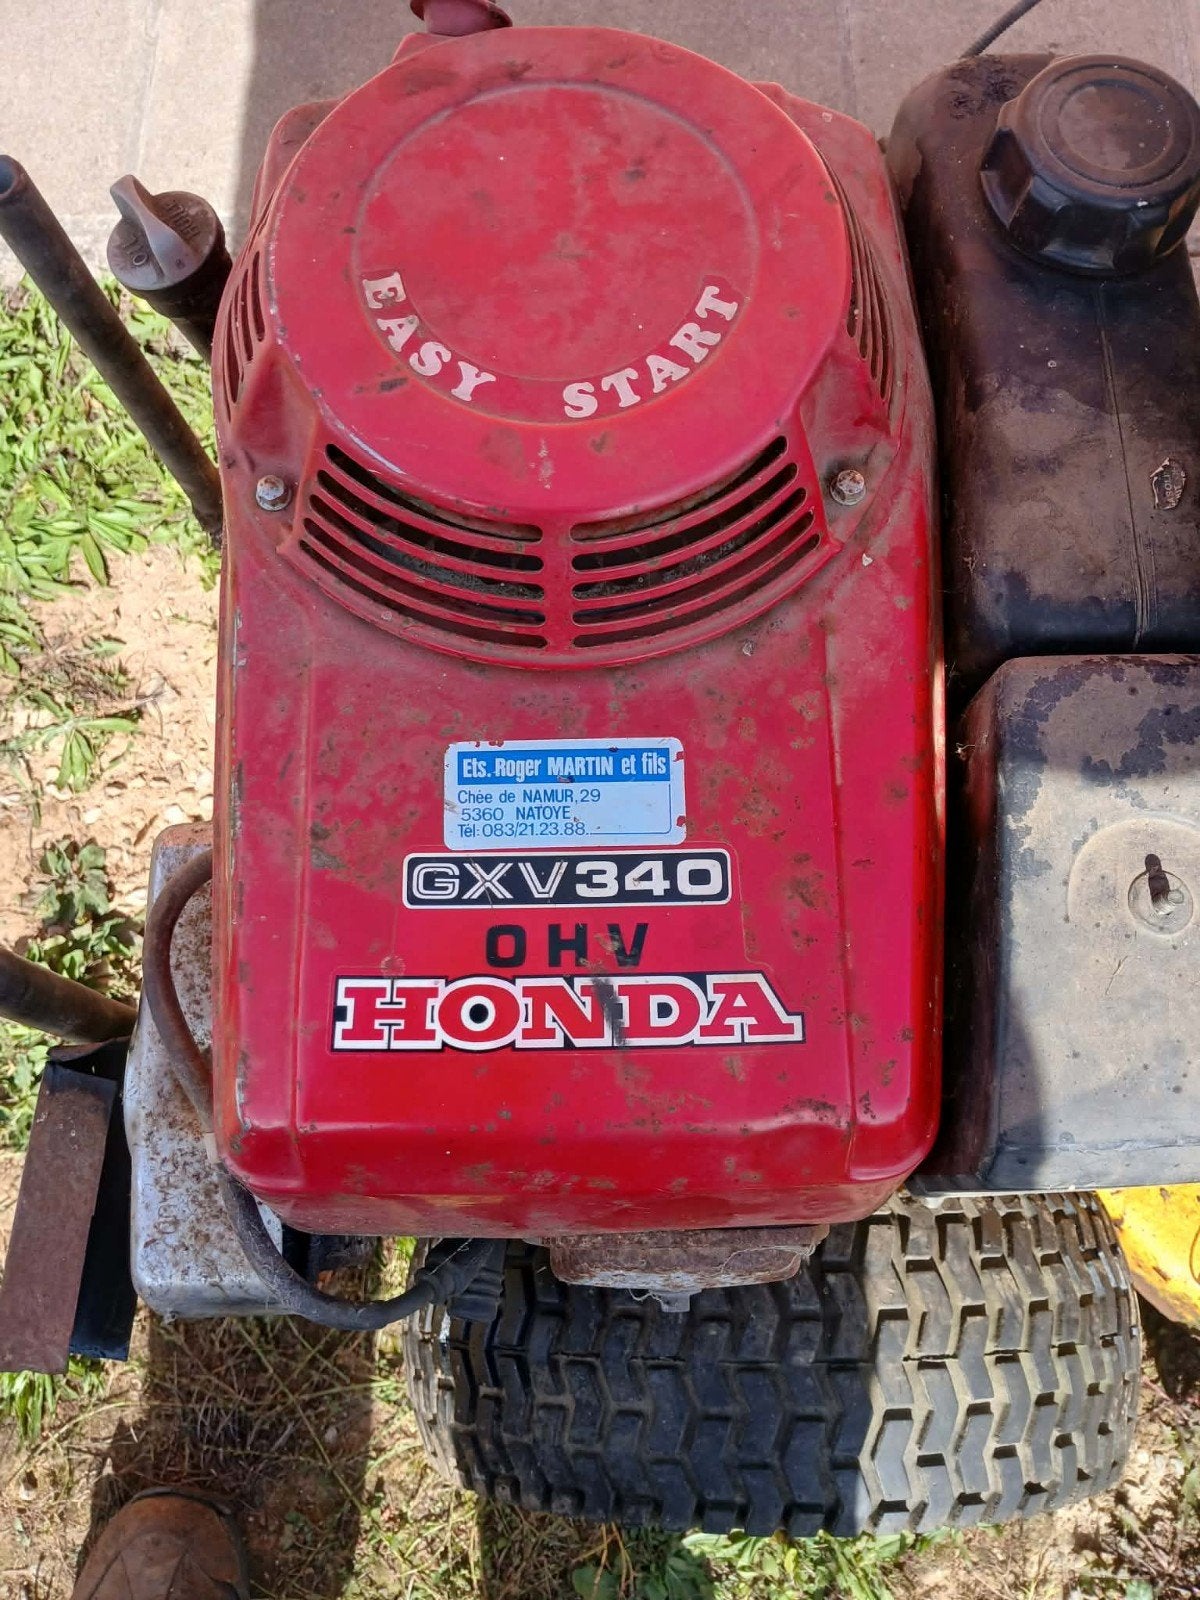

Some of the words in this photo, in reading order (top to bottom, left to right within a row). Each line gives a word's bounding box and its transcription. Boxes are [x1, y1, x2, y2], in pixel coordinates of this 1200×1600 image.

[121, 234, 149, 267] OIL
[362, 272, 496, 402] EASY
[562, 285, 738, 419] START
[462, 758, 491, 778] Ets.
[495, 758, 541, 782] Roger
[547, 756, 614, 777] MARTIN
[621, 758, 636, 775] et
[641, 752, 667, 775] fils
[498, 789, 516, 803] de
[460, 807, 504, 821] 5360
[413, 858, 724, 900] GXV340
[333, 974, 806, 1051] HONDA
